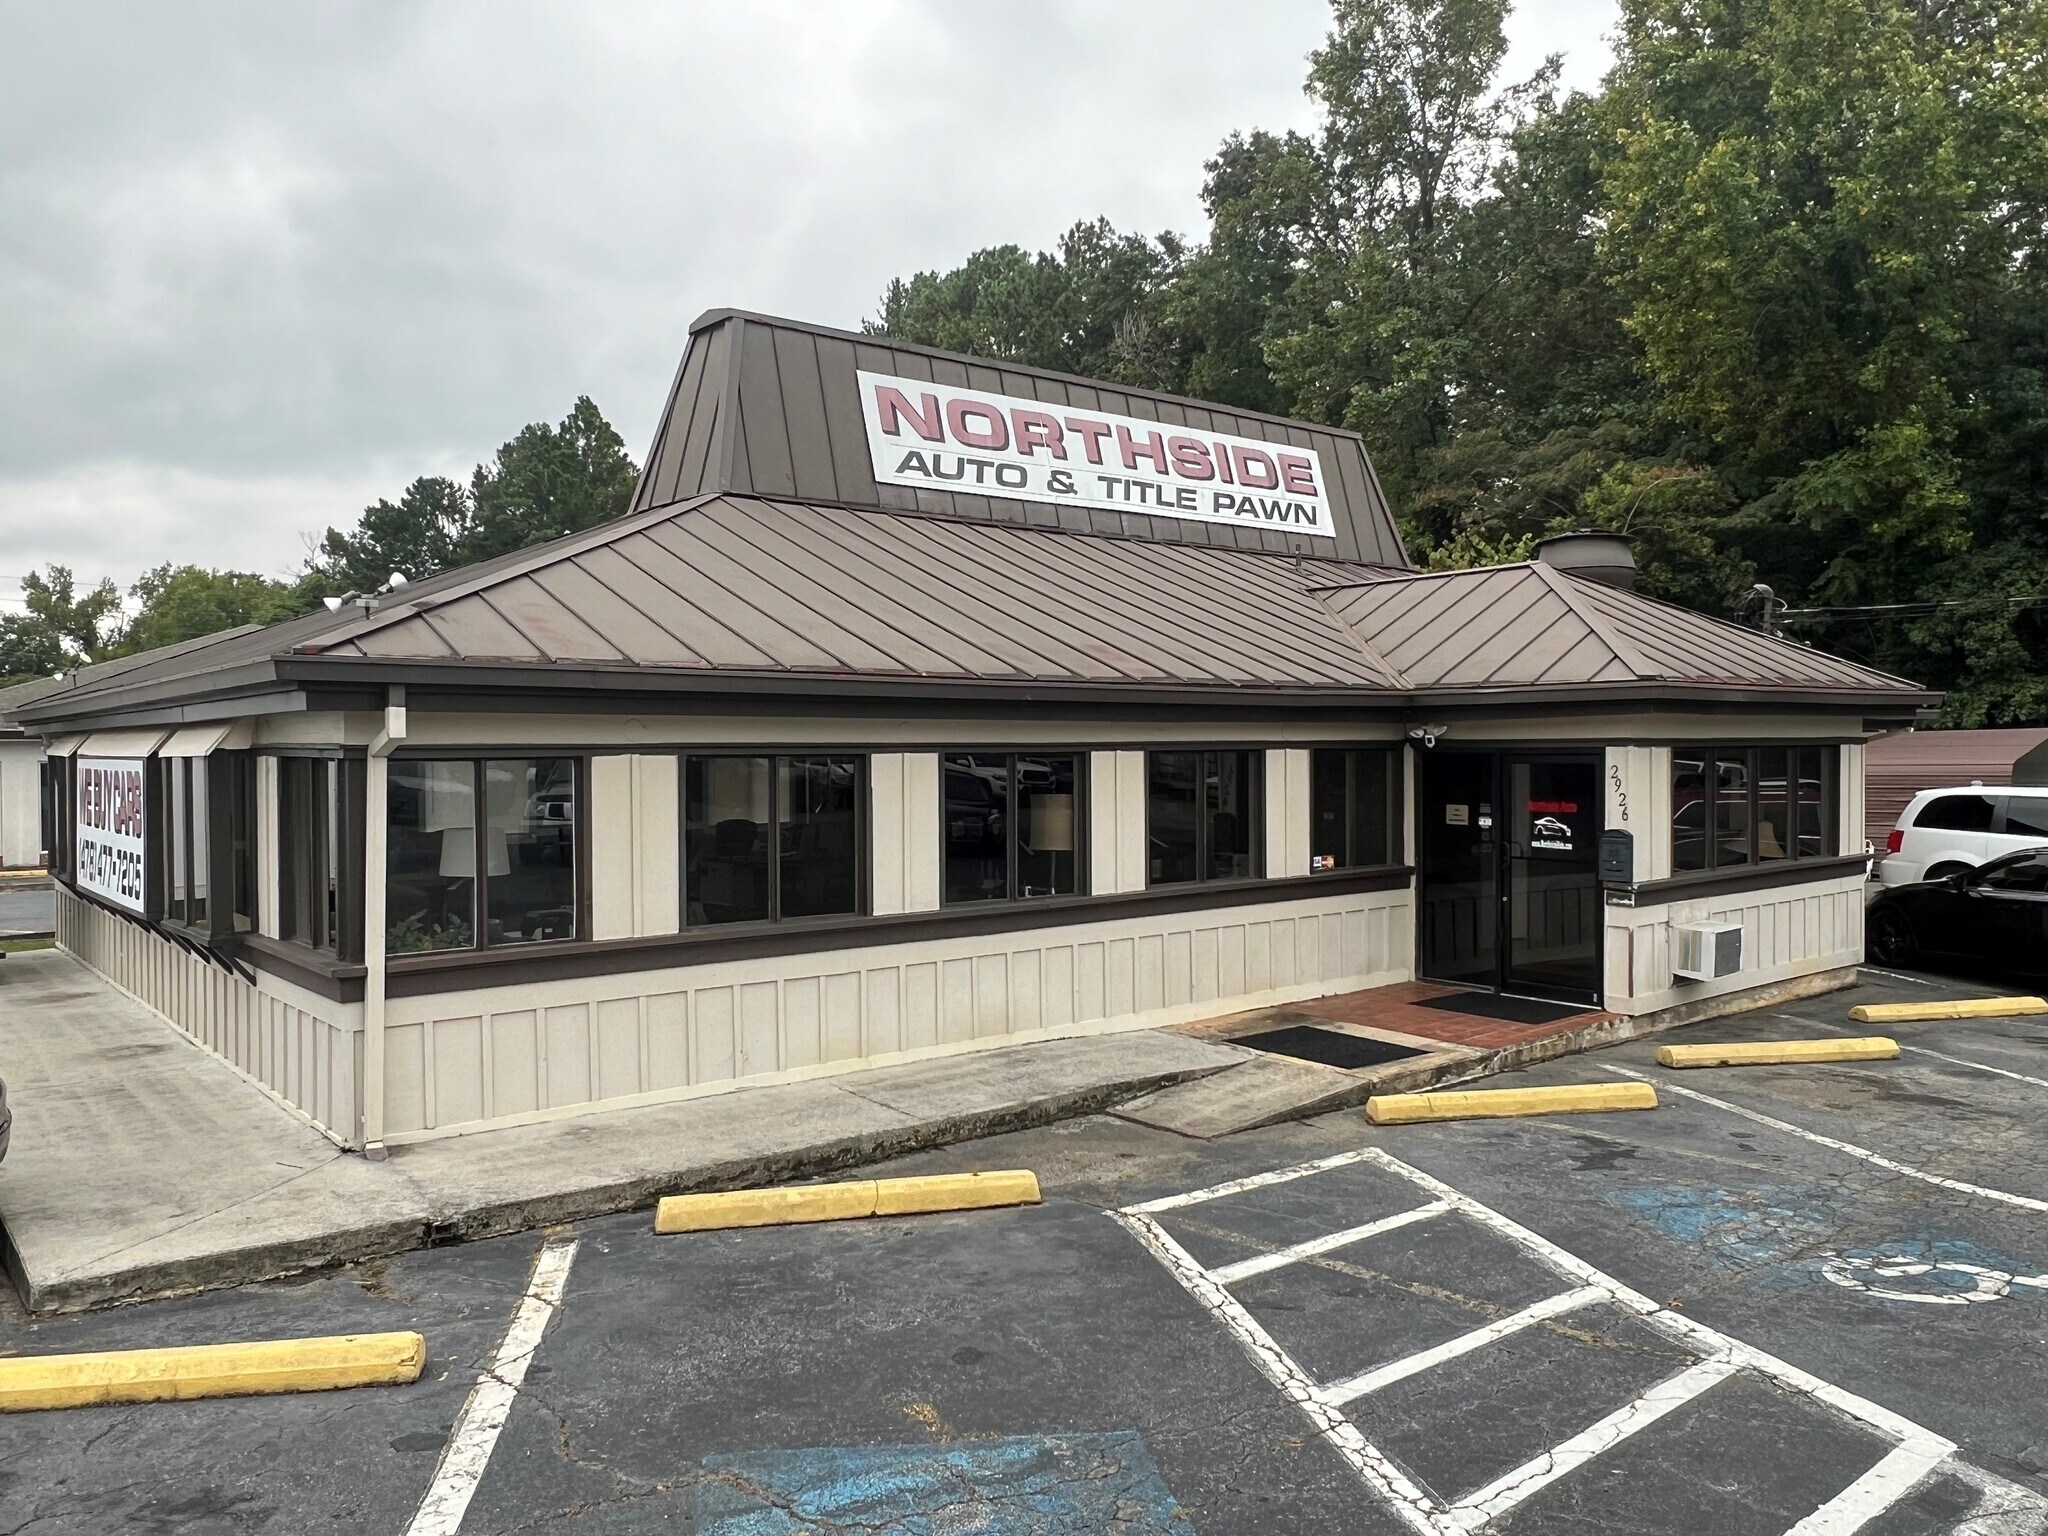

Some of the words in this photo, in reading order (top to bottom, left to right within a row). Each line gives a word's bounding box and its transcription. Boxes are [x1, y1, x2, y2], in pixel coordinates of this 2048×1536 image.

[875, 385, 1317, 496] NORTHSIDE
[895, 451, 1027, 488] AUTO
[1046, 471, 1077, 494] &
[1098, 476, 1198, 510] TITLE
[1213, 494, 1316, 526] PAWN
[79, 768, 91, 826] WE
[94, 769, 112, 831] BUY
[114, 770, 141, 838] CARS
[1610, 765, 1628, 821] 2926
